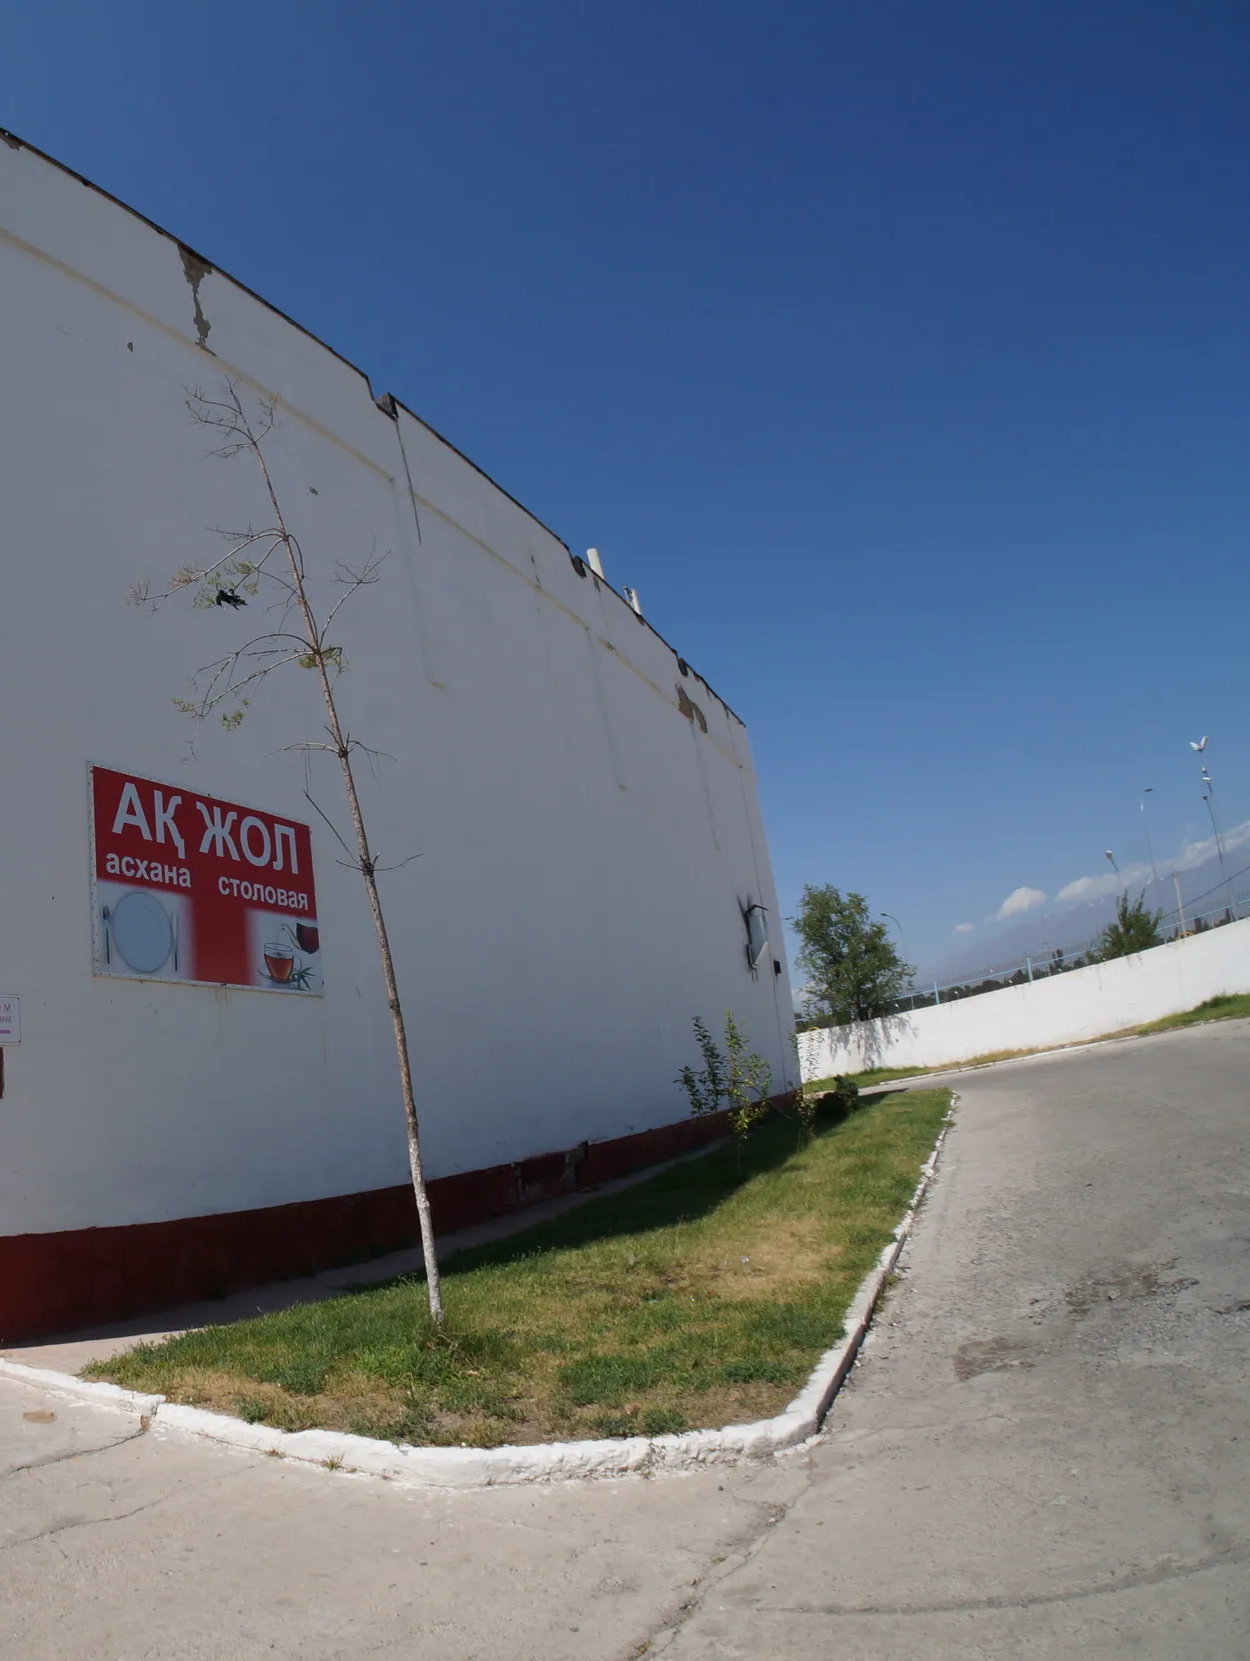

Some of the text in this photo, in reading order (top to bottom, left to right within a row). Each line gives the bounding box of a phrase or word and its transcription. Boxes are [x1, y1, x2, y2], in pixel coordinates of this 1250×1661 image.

[111, 781, 299, 875] АҚ ЖОЛ
[105, 852, 192, 888] асхана
[218, 875, 309, 911] столовая
